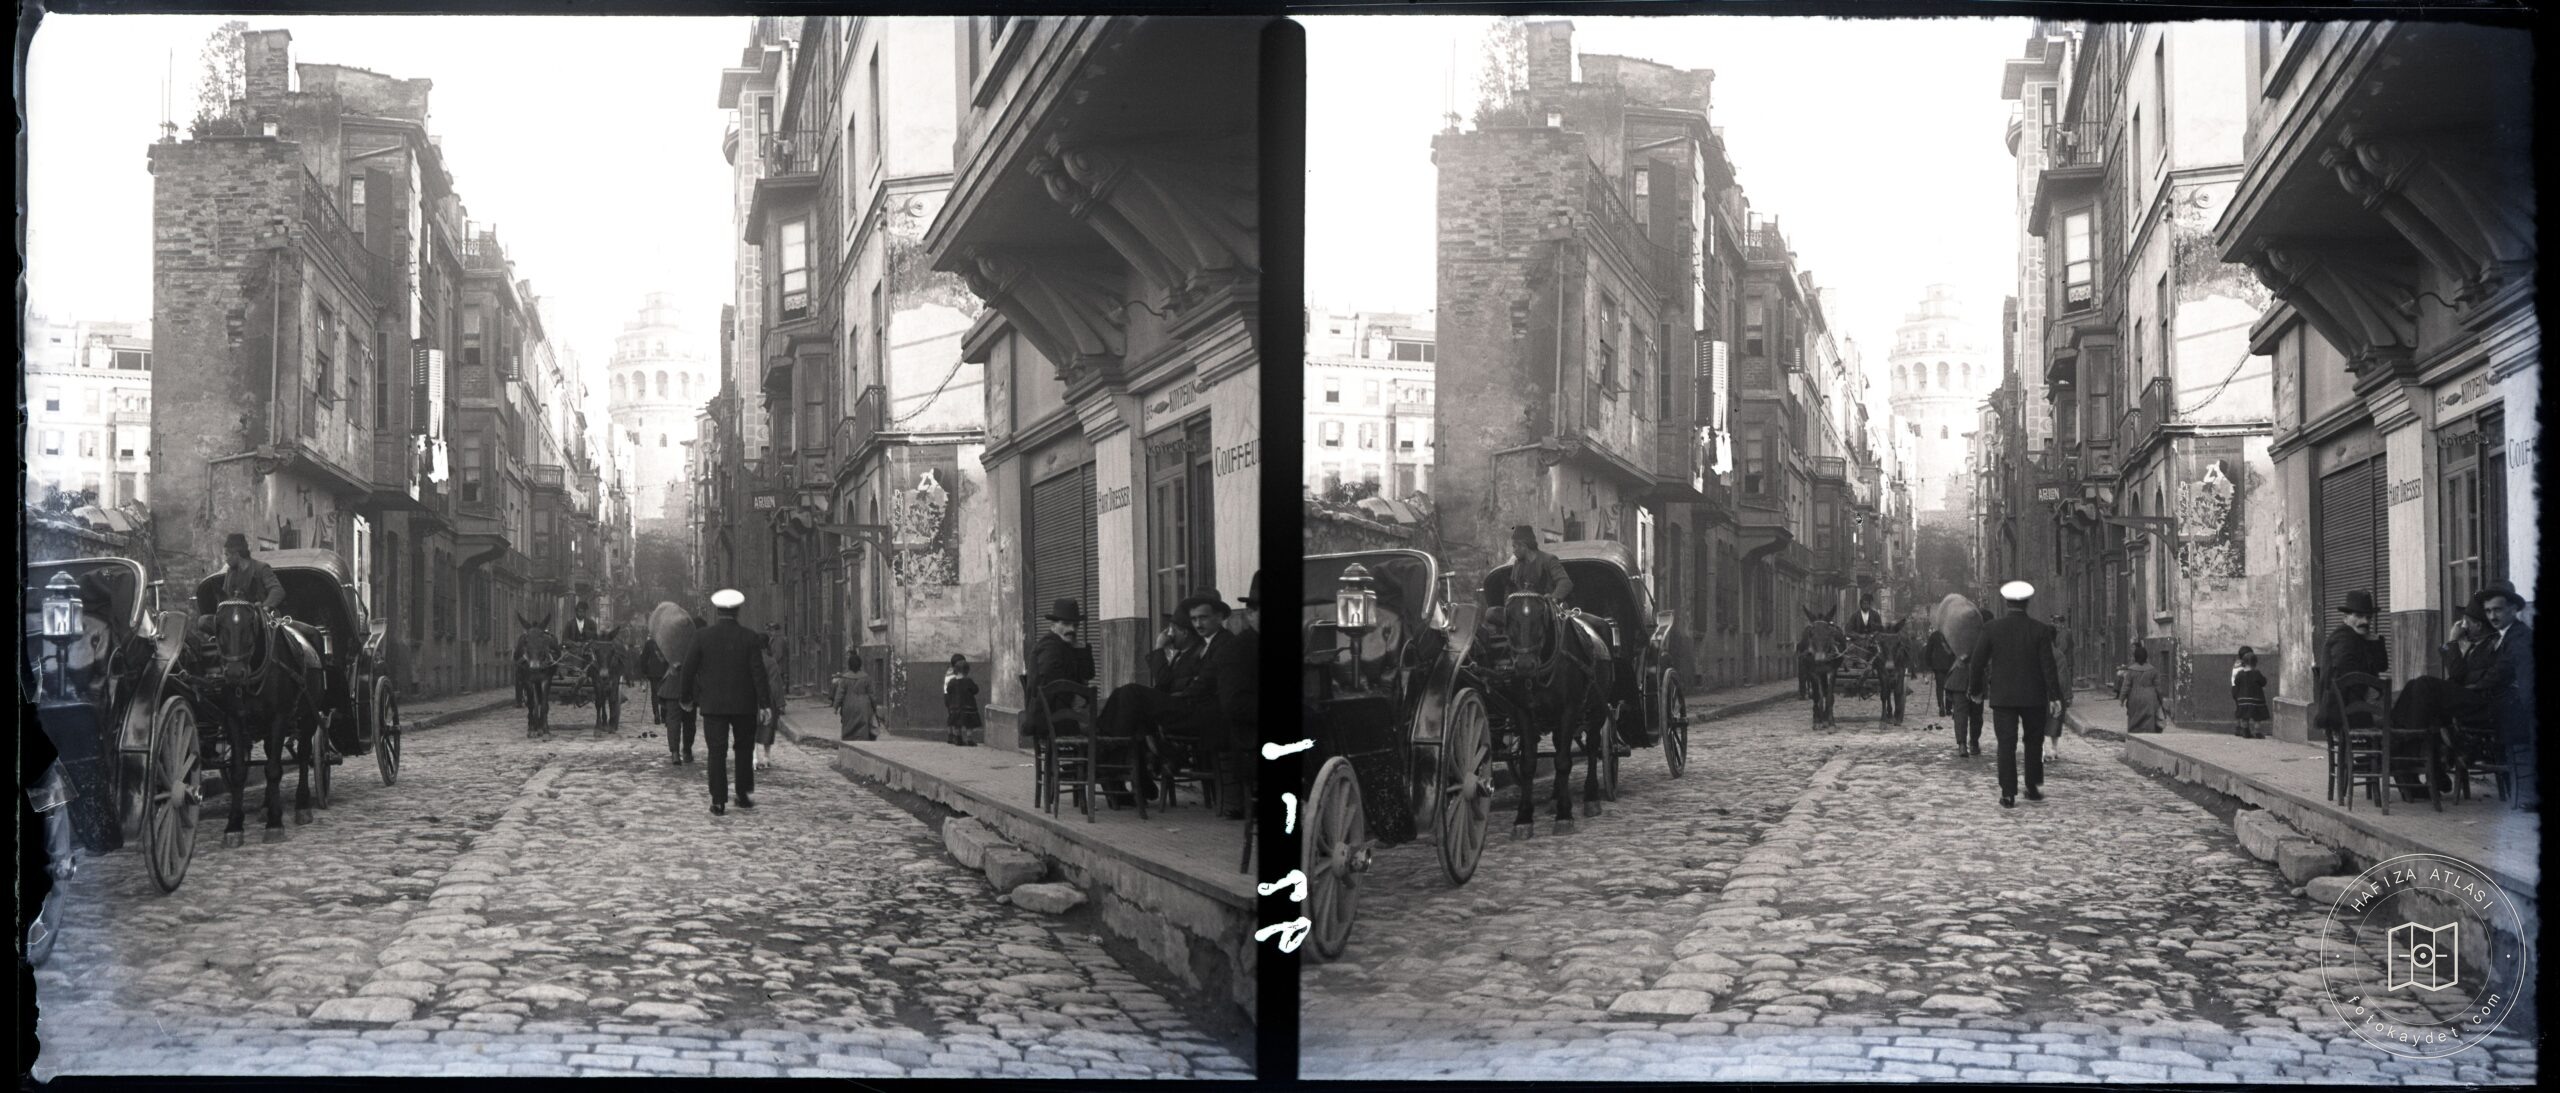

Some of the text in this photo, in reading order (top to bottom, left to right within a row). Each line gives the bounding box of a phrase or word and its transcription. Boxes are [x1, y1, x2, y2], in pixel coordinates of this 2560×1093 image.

[1108, 486, 1131, 511] DRESSER
[2388, 478, 2422, 507] HAIR DRESSER
